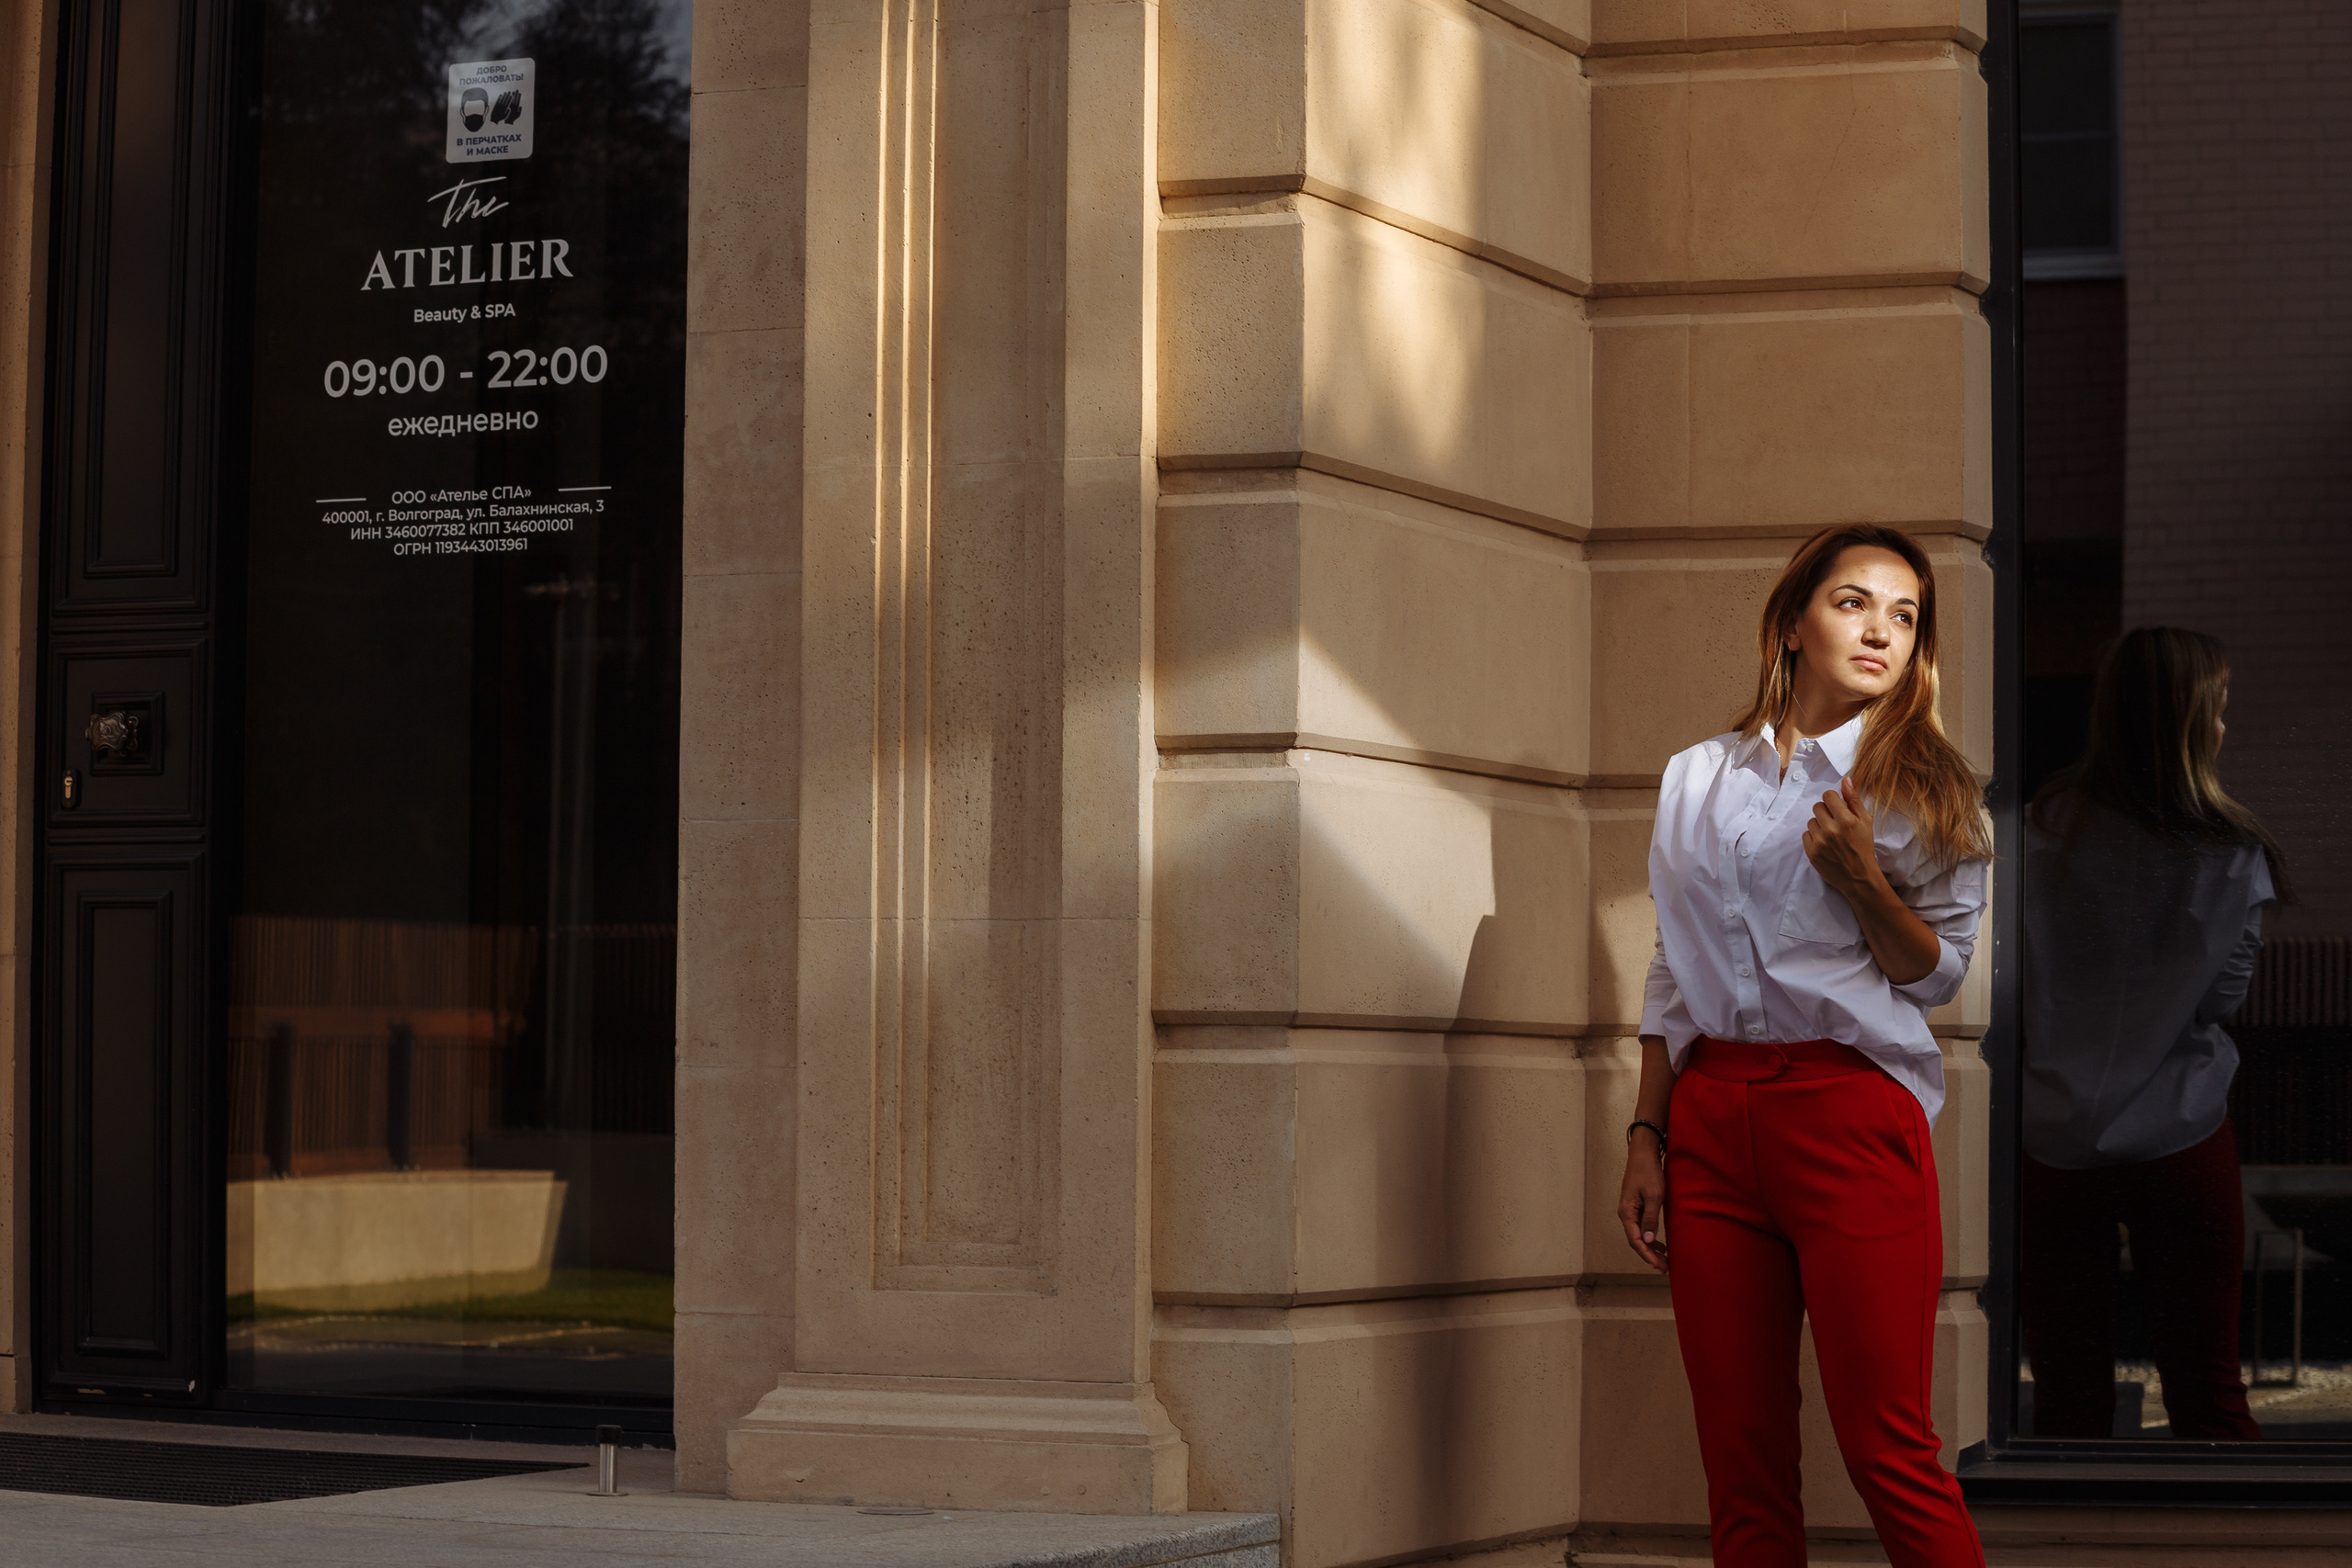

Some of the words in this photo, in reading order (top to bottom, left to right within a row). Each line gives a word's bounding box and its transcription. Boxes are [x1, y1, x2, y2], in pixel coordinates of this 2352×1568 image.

[476, 65, 507, 75] ДОБРО
[457, 138, 464, 146] В
[466, 134, 522, 145] ПЕРЧАТКАХ
[476, 145, 509, 156] МАСКЕ
[427, 176, 509, 229] The
[360, 239, 574, 291] ATELIER
[413, 307, 468, 323] Beauty
[470, 305, 481, 320] &
[484, 302, 516, 319] SPA
[323, 355, 446, 398] 09:00
[487, 344, 608, 389] 22:00
[388, 411, 538, 438] ежедневно
[391, 490, 426, 504] ООО
[430, 488, 488, 502] «Ателье
[492, 486, 532, 501] СПА»
[322, 510, 373, 525] 400001,
[376, 512, 385, 522] г.
[389, 508, 463, 522] Волгоград,
[466, 508, 486, 521] ул.
[489, 502, 593, 517] Балахнинская,
[595, 499, 605, 513] 3
[350, 527, 381, 540] ИНН
[384, 523, 466, 539] 3460077382
[469, 521, 500, 535] КПП
[503, 518, 573, 534] 346001001
[393, 542, 432, 556] ОГРН
[435, 537, 527, 554] 1193443013961
